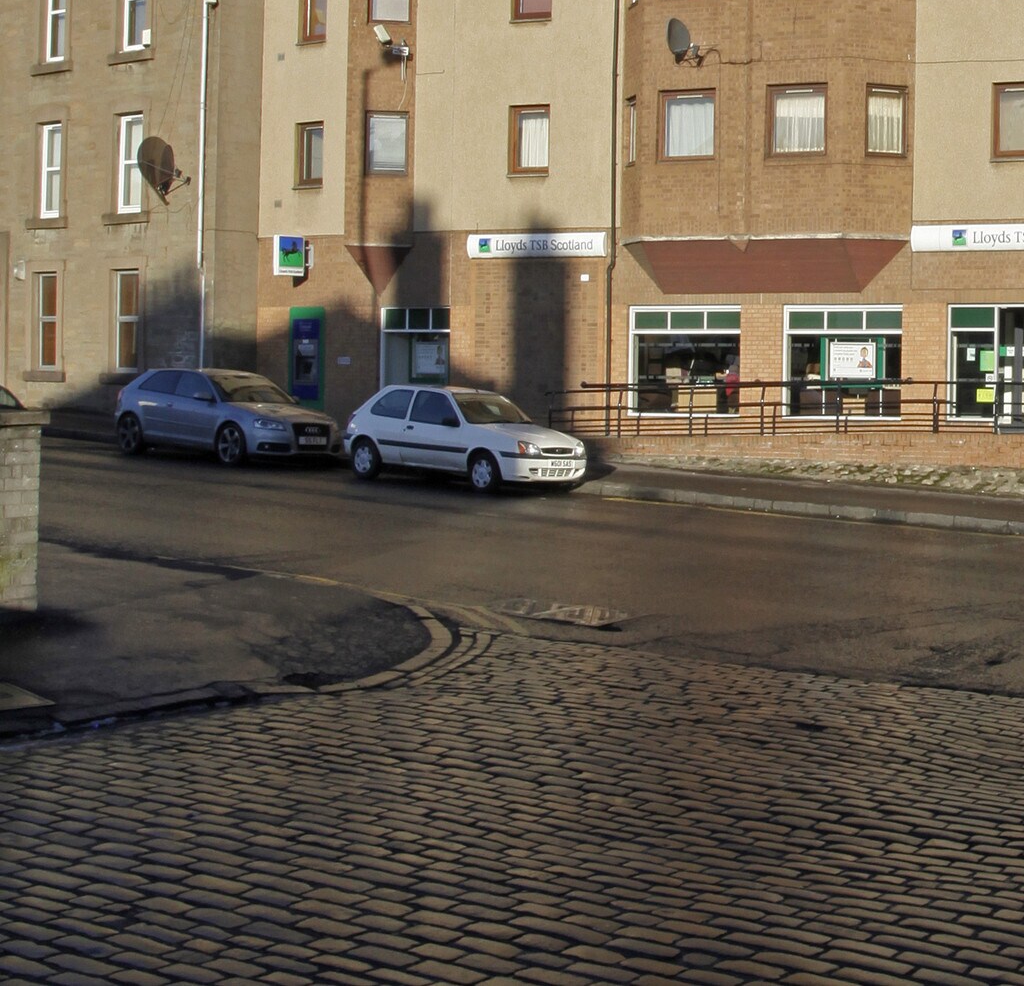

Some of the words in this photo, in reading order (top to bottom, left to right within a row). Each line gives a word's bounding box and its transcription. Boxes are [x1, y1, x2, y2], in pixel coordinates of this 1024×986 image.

[495, 239, 528, 254] Lloyds
[529, 239, 549, 251] TSB
[550, 239, 594, 251] Scotland
[972, 230, 1011, 247] Lloyds
